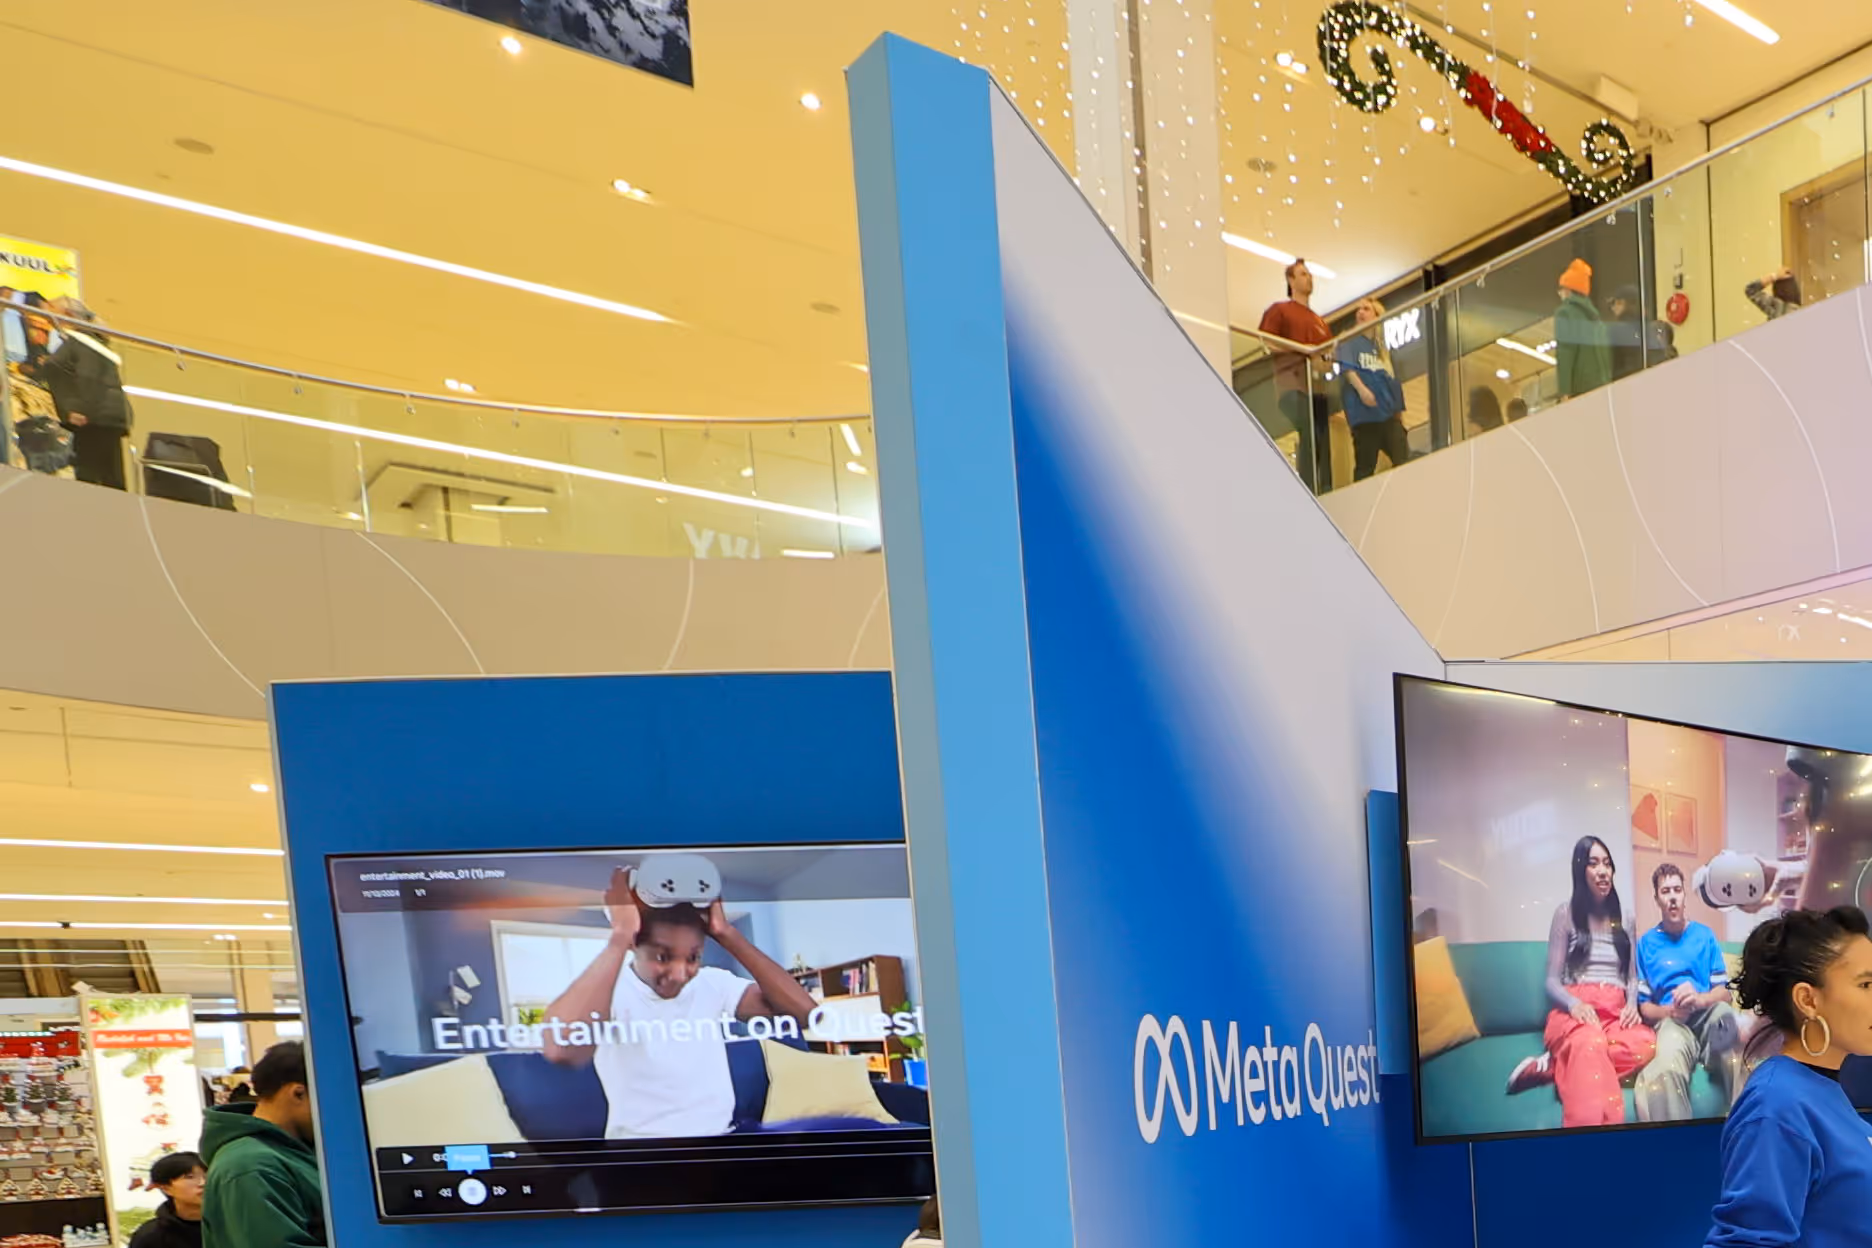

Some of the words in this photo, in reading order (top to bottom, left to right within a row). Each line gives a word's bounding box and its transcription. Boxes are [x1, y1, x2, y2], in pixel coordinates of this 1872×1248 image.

[431, 1010, 739, 1050] Entertainment
[748, 1014, 799, 1041] on
[1202, 1020, 1301, 1130] Meta
[1304, 1022, 1380, 1127] Quest
